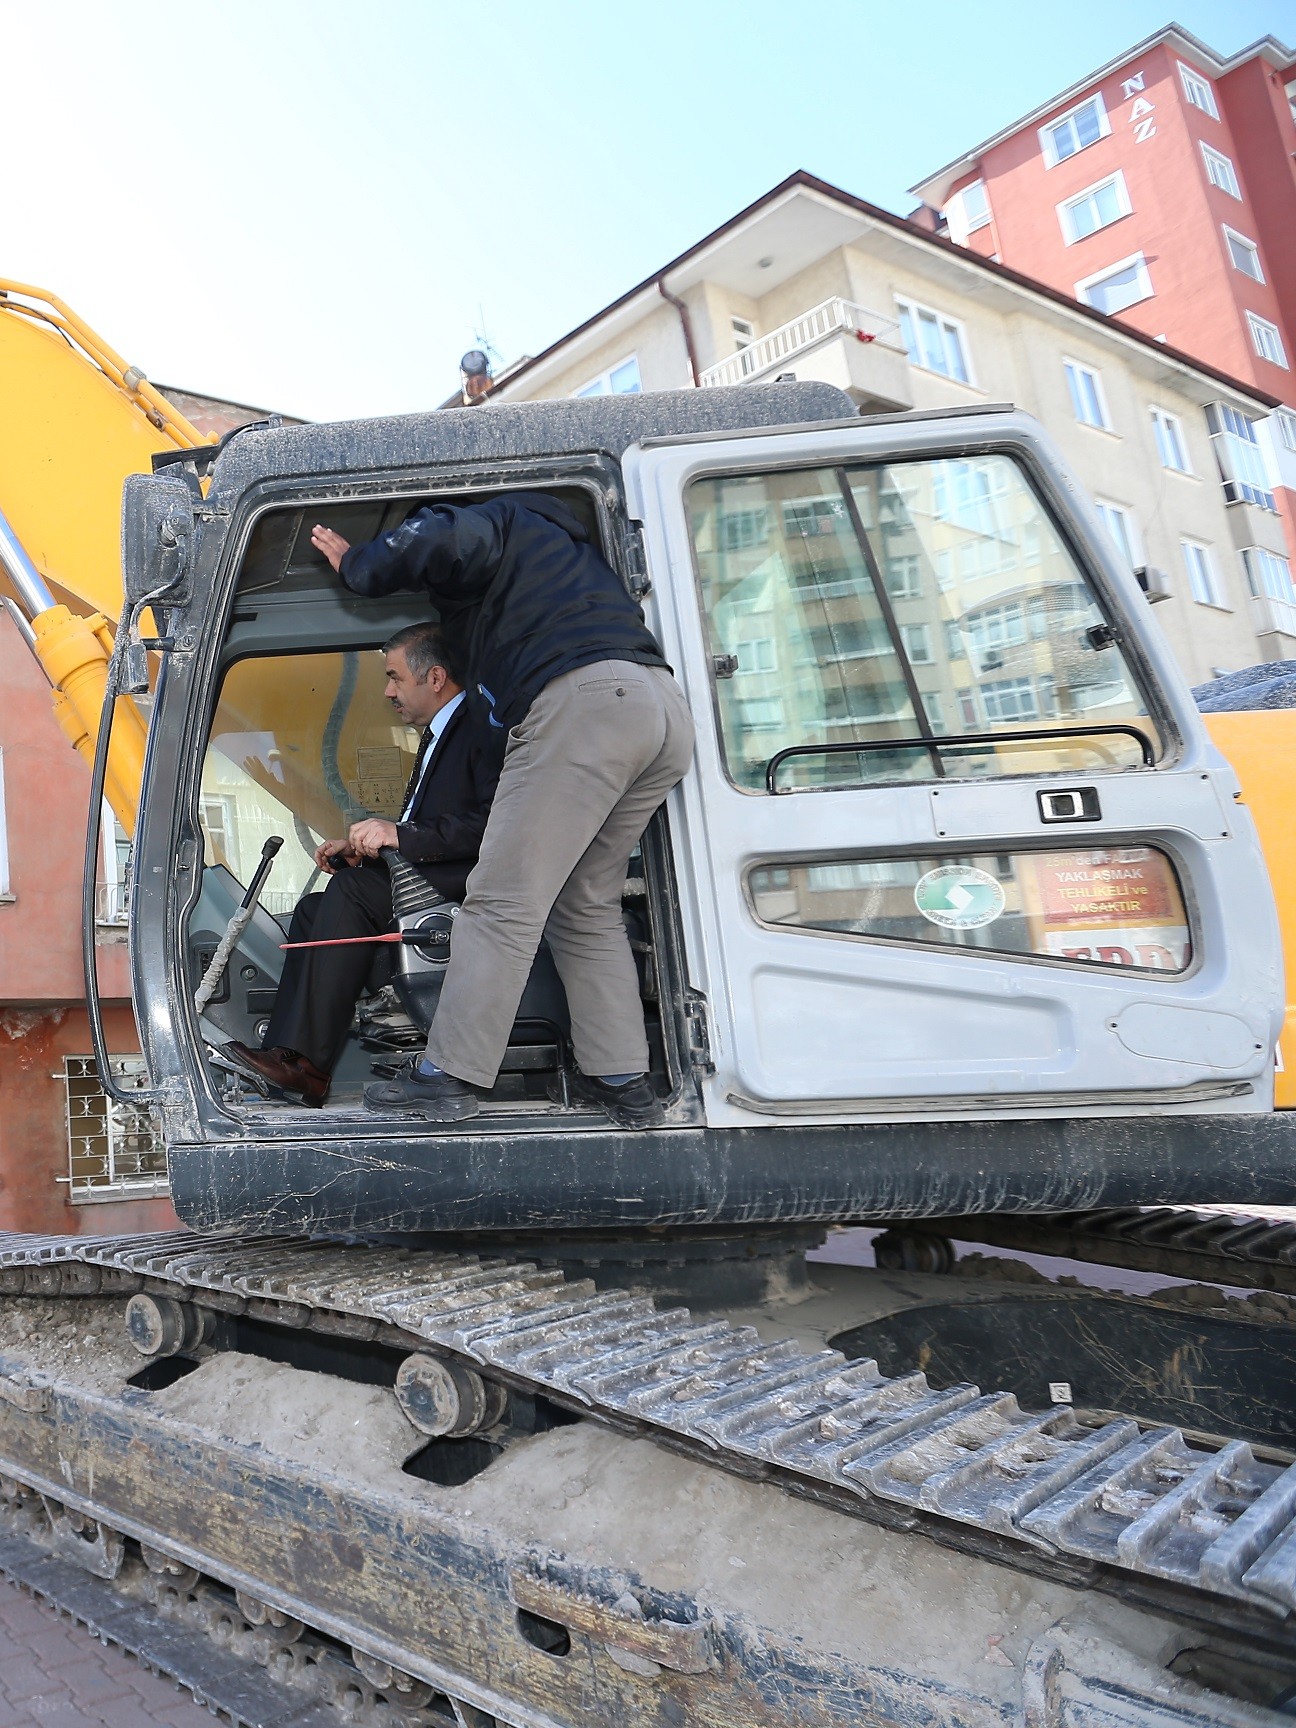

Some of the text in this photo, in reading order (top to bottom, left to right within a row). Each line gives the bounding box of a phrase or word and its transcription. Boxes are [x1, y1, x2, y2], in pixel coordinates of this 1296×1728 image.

[1120, 71, 1156, 144] NAZ
[1055, 868, 1144, 883] YAKLAŞMAK
[1058, 883, 1149, 899] TEHLİKELİ ve
[1070, 900, 1142, 914] YASAKTIR
